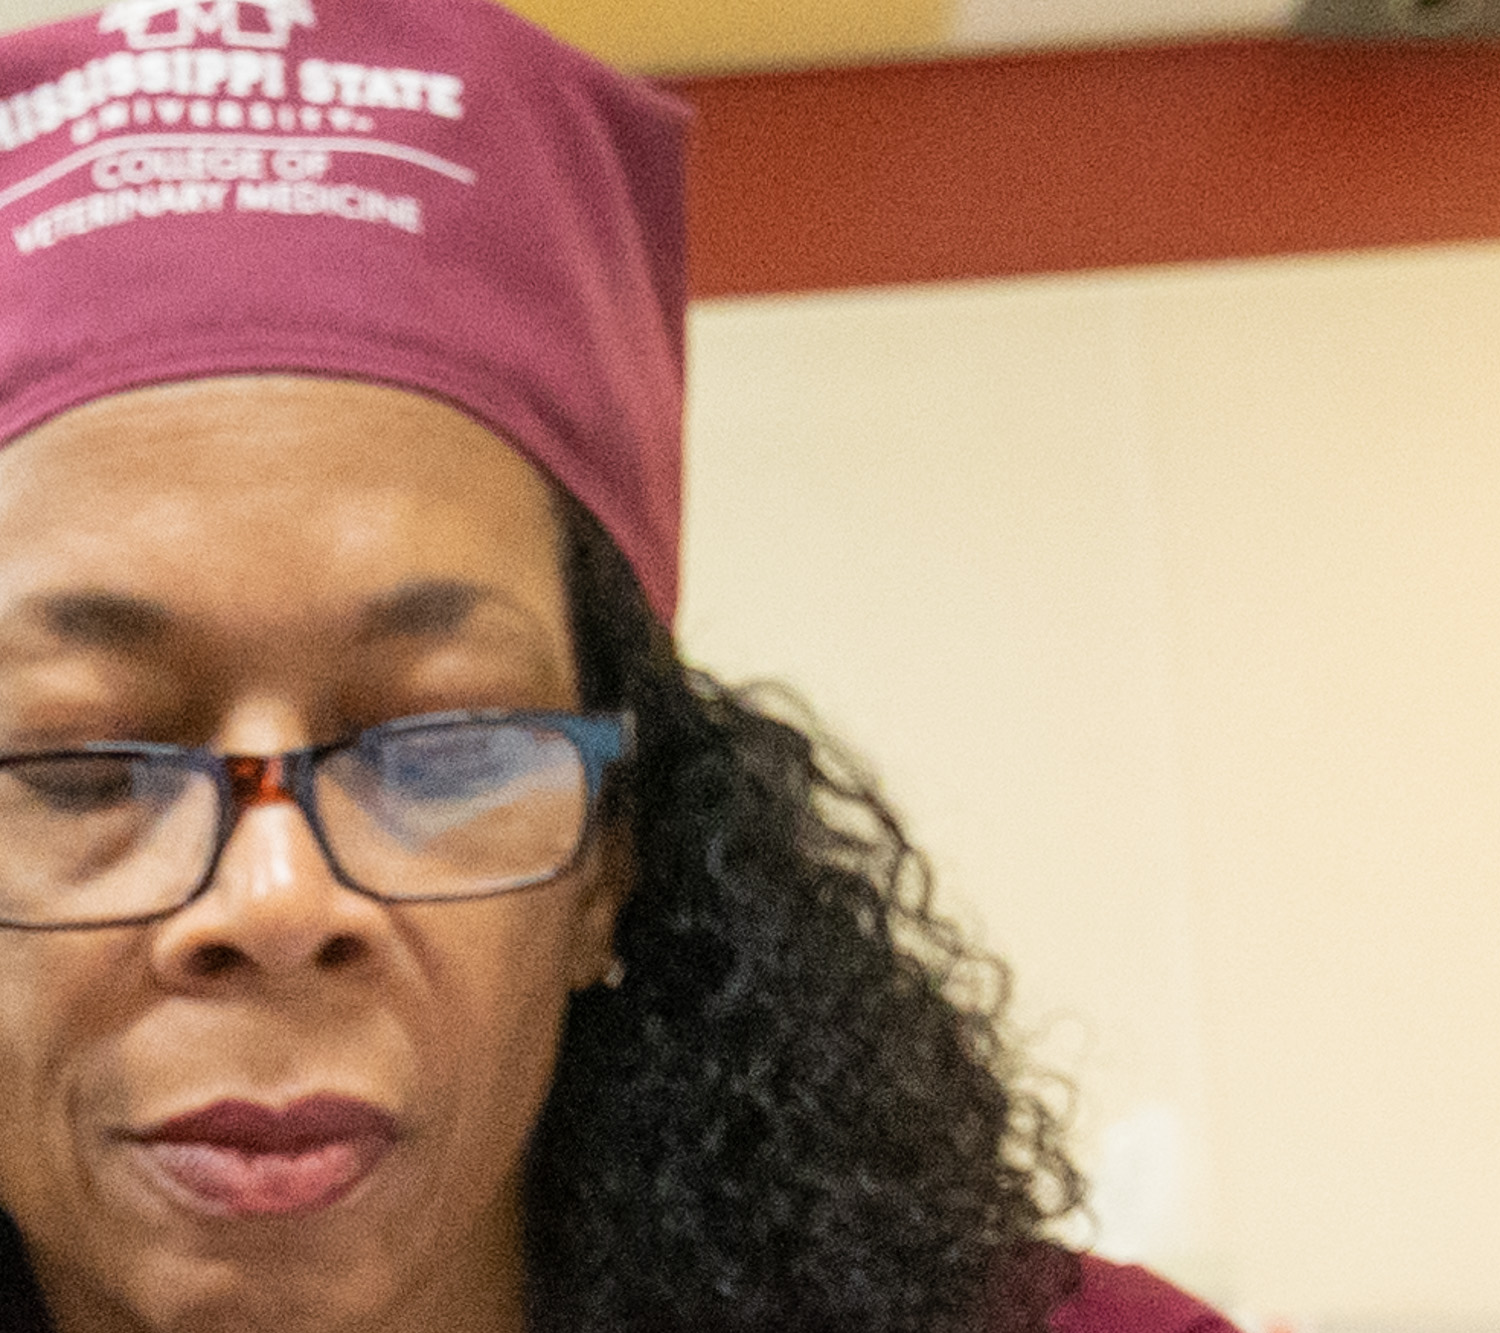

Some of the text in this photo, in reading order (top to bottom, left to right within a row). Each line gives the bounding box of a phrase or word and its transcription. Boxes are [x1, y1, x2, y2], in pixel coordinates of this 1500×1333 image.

[299, 57, 464, 120] STATE
[91, 149, 331, 189] COLLEGE OF
[12, 180, 426, 254] VETERINARY MEDICINE
